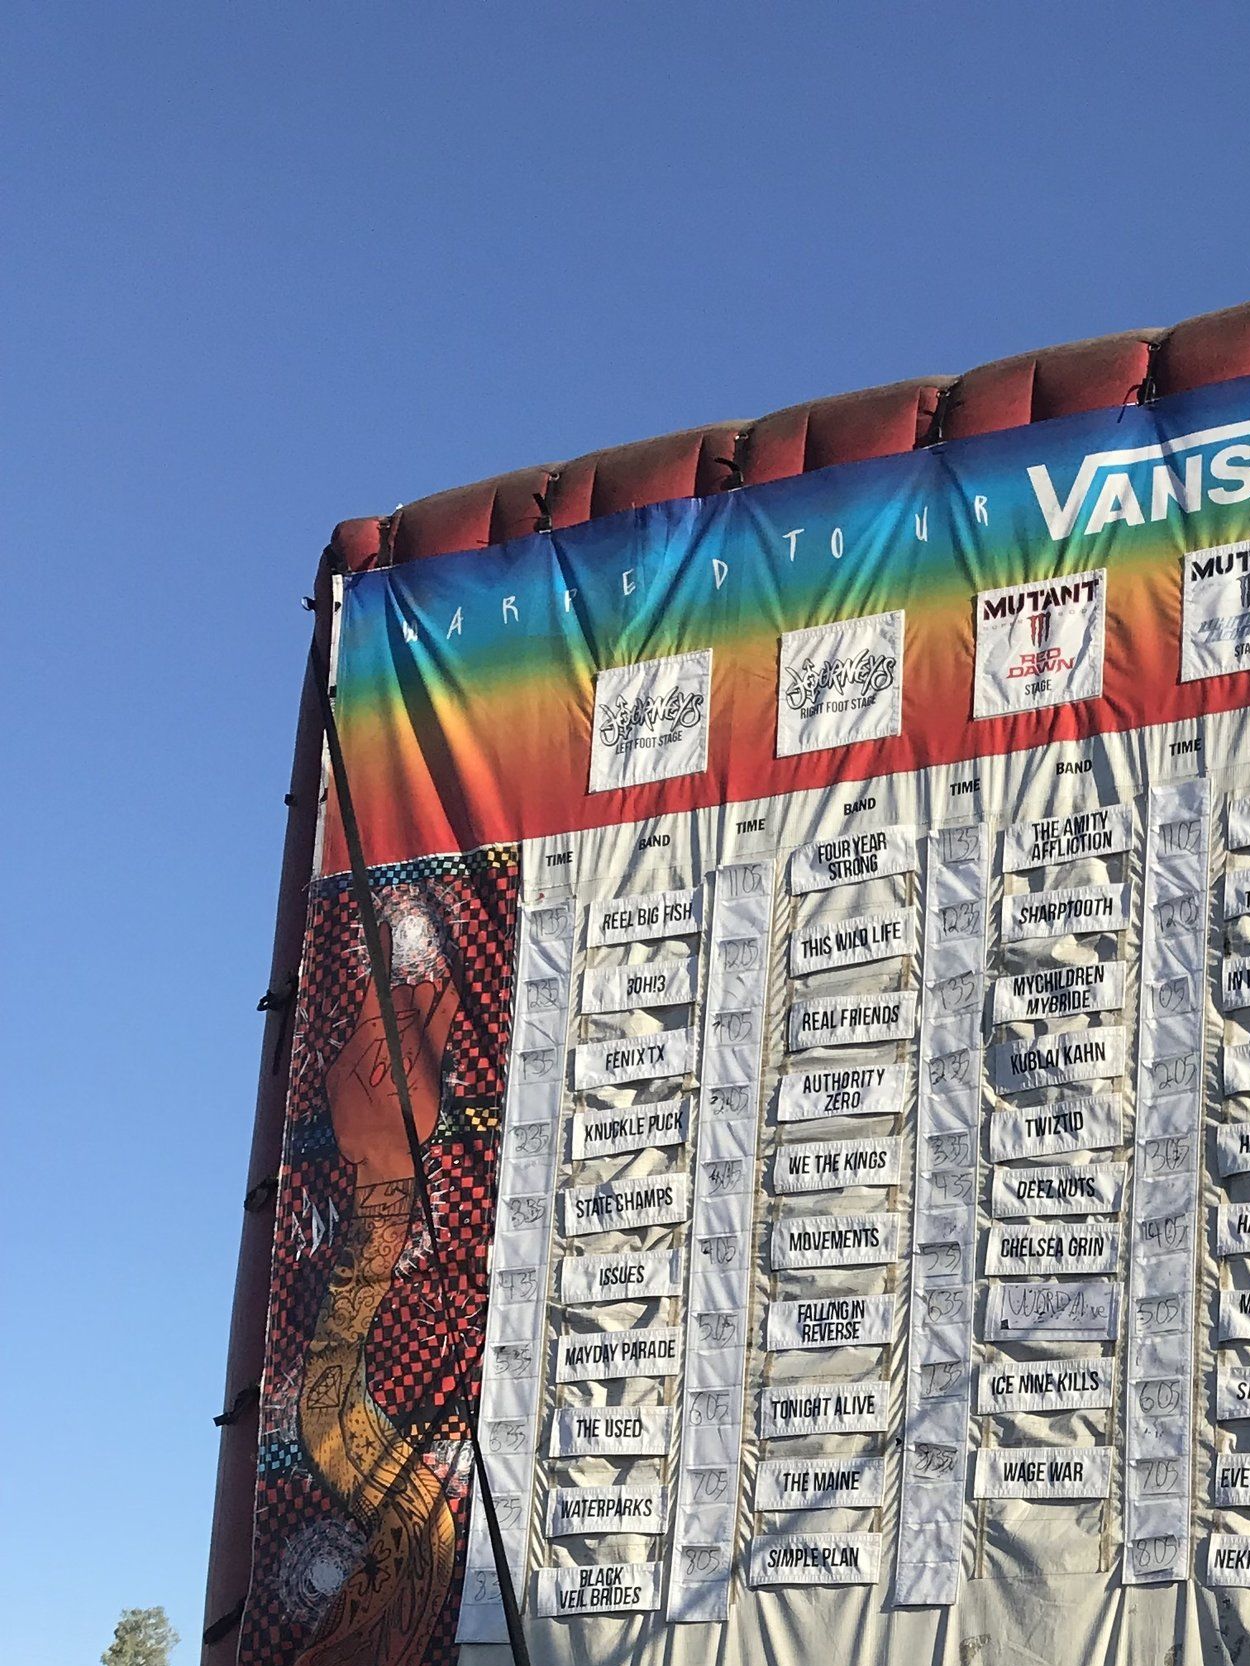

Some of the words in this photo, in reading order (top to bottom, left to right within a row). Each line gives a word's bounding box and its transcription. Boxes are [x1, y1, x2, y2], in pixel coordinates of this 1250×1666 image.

[782, 495, 989, 562] TOUR
[983, 579, 1099, 620] MUTANT
[1007, 658, 1075, 679] DAWN
[1019, 648, 1061, 665] RED
[1025, 680, 1052, 695] STAGE
[801, 704, 823, 719] RIGHT
[826, 700, 848, 713] FOOT
[851, 695, 876, 710] STAGE
[616, 736, 633, 754] LEFT
[634, 734, 656, 748] FOOT
[658, 731, 682, 746] STAGE
[638, 834, 671, 851] BAND
[818, 843, 849, 863] FOUR
[852, 831, 887, 856] YEAR
[545, 851, 573, 867] TIME
[829, 856, 878, 880] STRONG
[602, 910, 634, 931] REEL
[638, 906, 659, 926] BIG
[663, 902, 693, 924] FISH
[1018, 897, 1113, 925] SHARPTOOTH
[801, 935, 832, 959] THIS
[835, 928, 868, 952] WILD
[873, 922, 901, 942] LIFE
[1013, 966, 1104, 995] MYCHILDREN
[1026, 991, 1091, 1015] MYBRIDE
[802, 1010, 837, 1032] REAL
[840, 1004, 900, 1027] FRIENDS
[605, 1048, 645, 1071] FENIX
[1010, 1048, 1060, 1076] KUBLAI
[1063, 1042, 1106, 1066] KAHN
[803, 1068, 885, 1094] AUTHORITY
[824, 1091, 861, 1112] ZERO
[584, 1117, 645, 1142] KNUCKLE
[648, 1110, 684, 1134] PUCK
[1025, 1111, 1084, 1138] TWIZTID
[1016, 1178, 1055, 1200] DEEZ
[1056, 1176, 1096, 1199] NUTS
[575, 1194, 614, 1219] STATE
[615, 1186, 673, 1213] CHAMPS
[789, 1227, 879, 1251] MOVEMENTS
[1000, 1237, 1064, 1258] CHELSEA
[1068, 1236, 1104, 1257] GRIN
[599, 1265, 645, 1286] ISSUES
[565, 1343, 619, 1366] MAYDAY
[622, 1339, 676, 1361] PARADE
[771, 1397, 832, 1420] TONIGHT
[834, 1395, 875, 1416] ALIVE
[576, 1418, 601, 1439] THE
[605, 1418, 643, 1438] USED
[783, 1471, 810, 1492] THE
[813, 1470, 861, 1492] MAINE
[1004, 1461, 1046, 1483] WAGE
[1049, 1461, 1083, 1483] WAR
[560, 1497, 653, 1519] WATERPARKS
[767, 1547, 820, 1568] SIMPLE
[822, 1547, 859, 1568] PLAN
[579, 1567, 624, 1588] BLACK
[559, 1588, 587, 1610] VEIL
[590, 1586, 642, 1607] BRIDES
